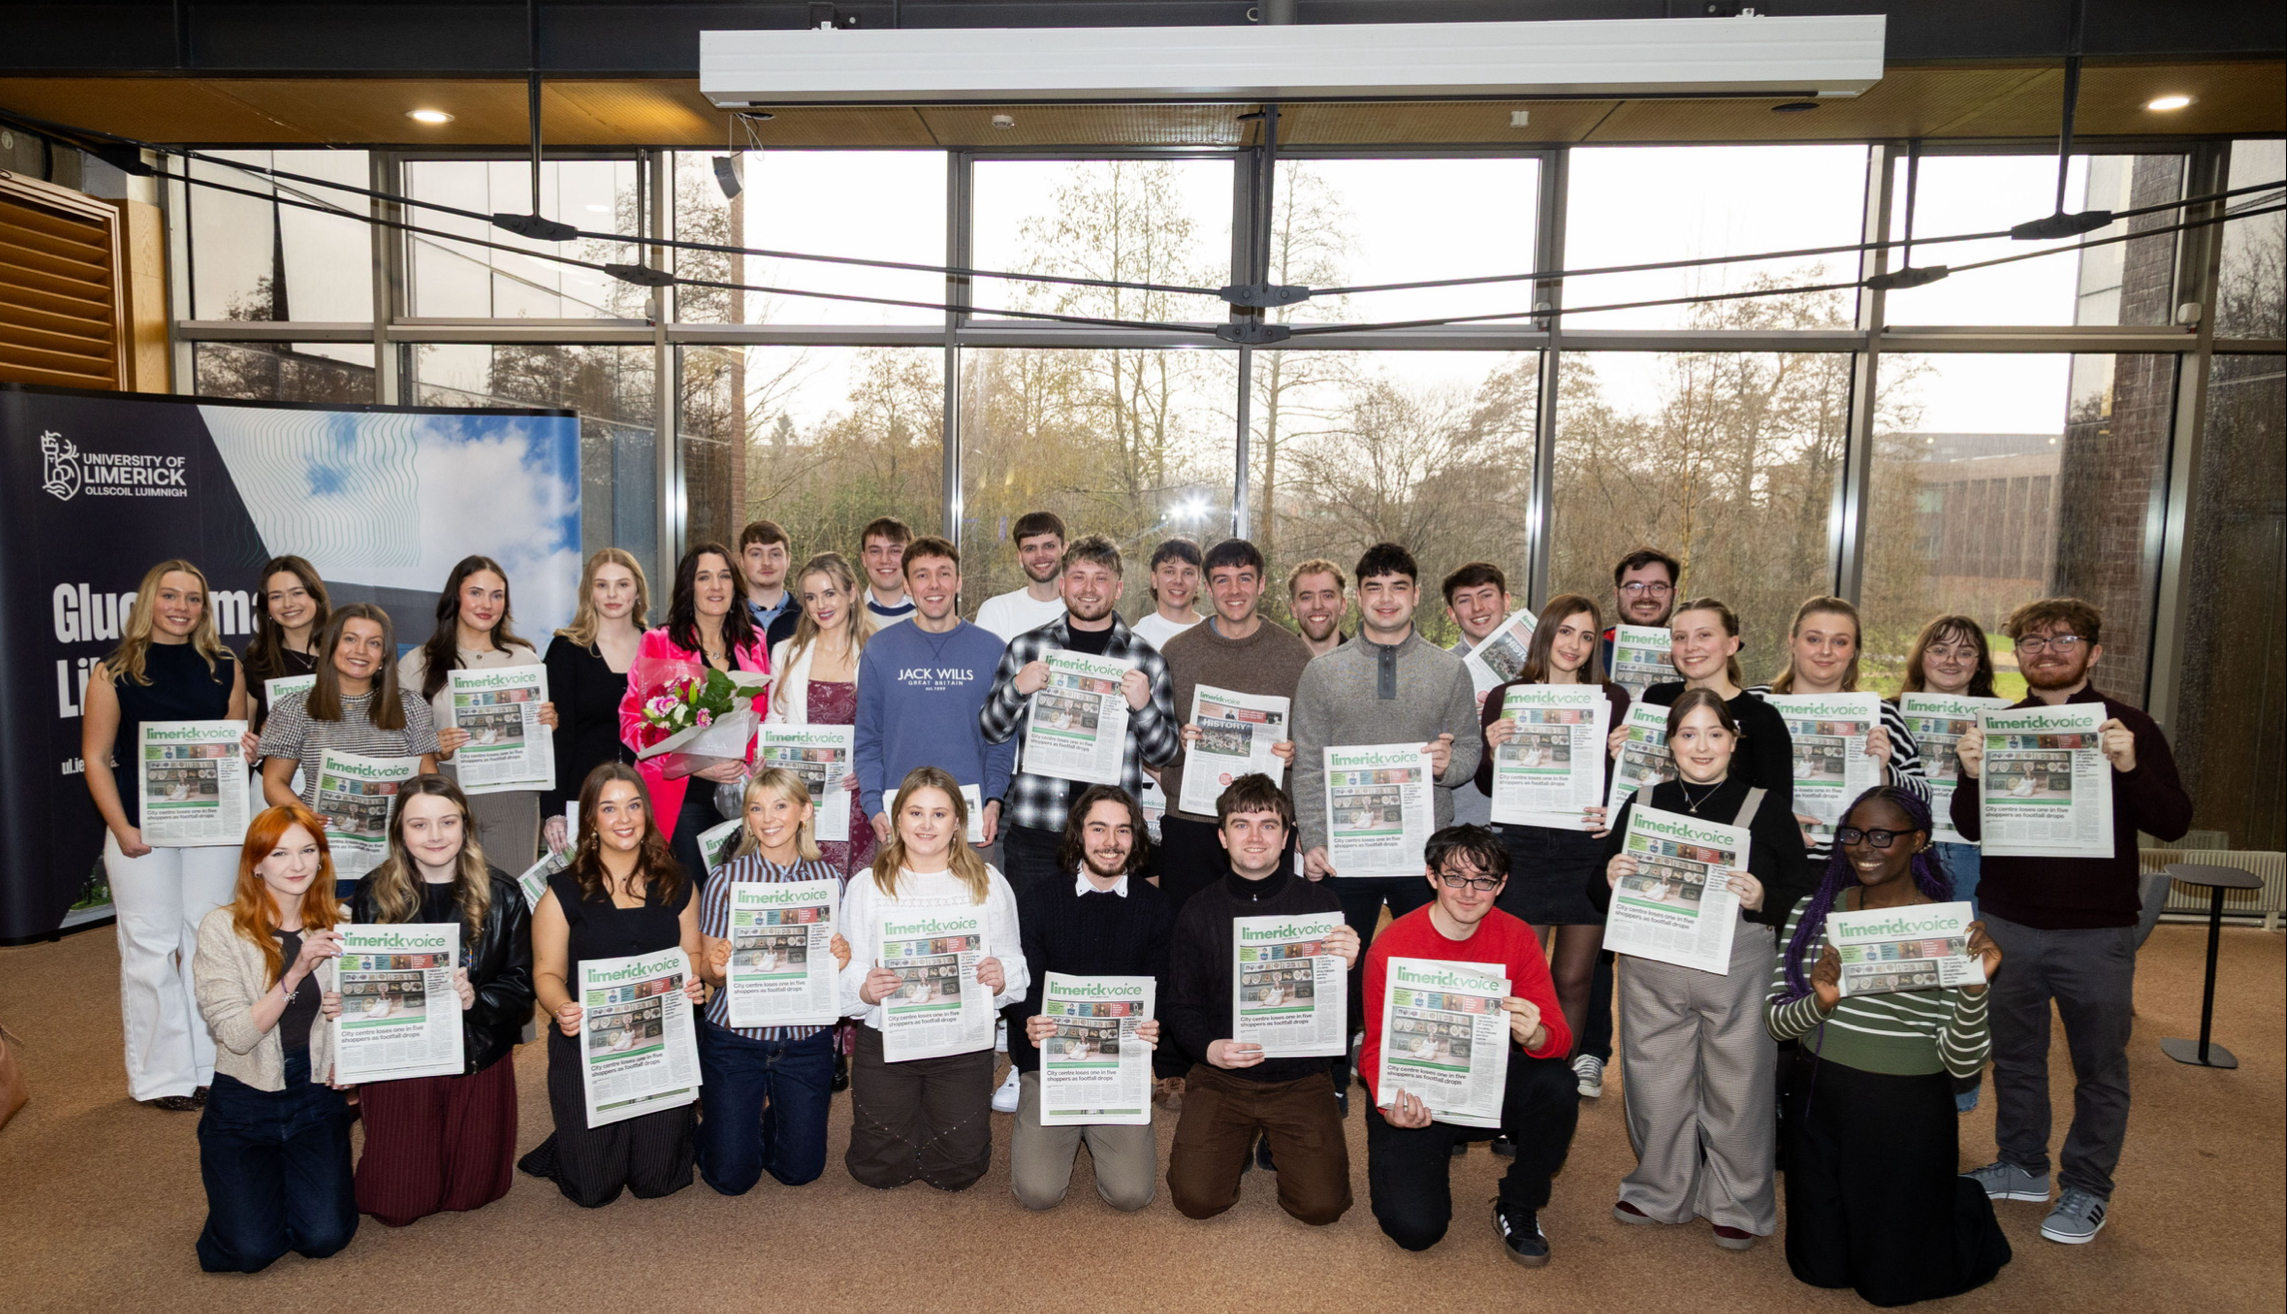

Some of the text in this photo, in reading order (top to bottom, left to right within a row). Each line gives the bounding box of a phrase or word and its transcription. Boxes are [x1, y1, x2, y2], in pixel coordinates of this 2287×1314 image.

[83, 452, 186, 468] UNIVERSITY OF
[84, 466, 186, 486] LIMERICK
[85, 486, 187, 497] OLLSCOIL LUIMNIGH
[898, 668, 974, 680] JACK WILLS
[1203, 719, 1247, 730] HISTORY
